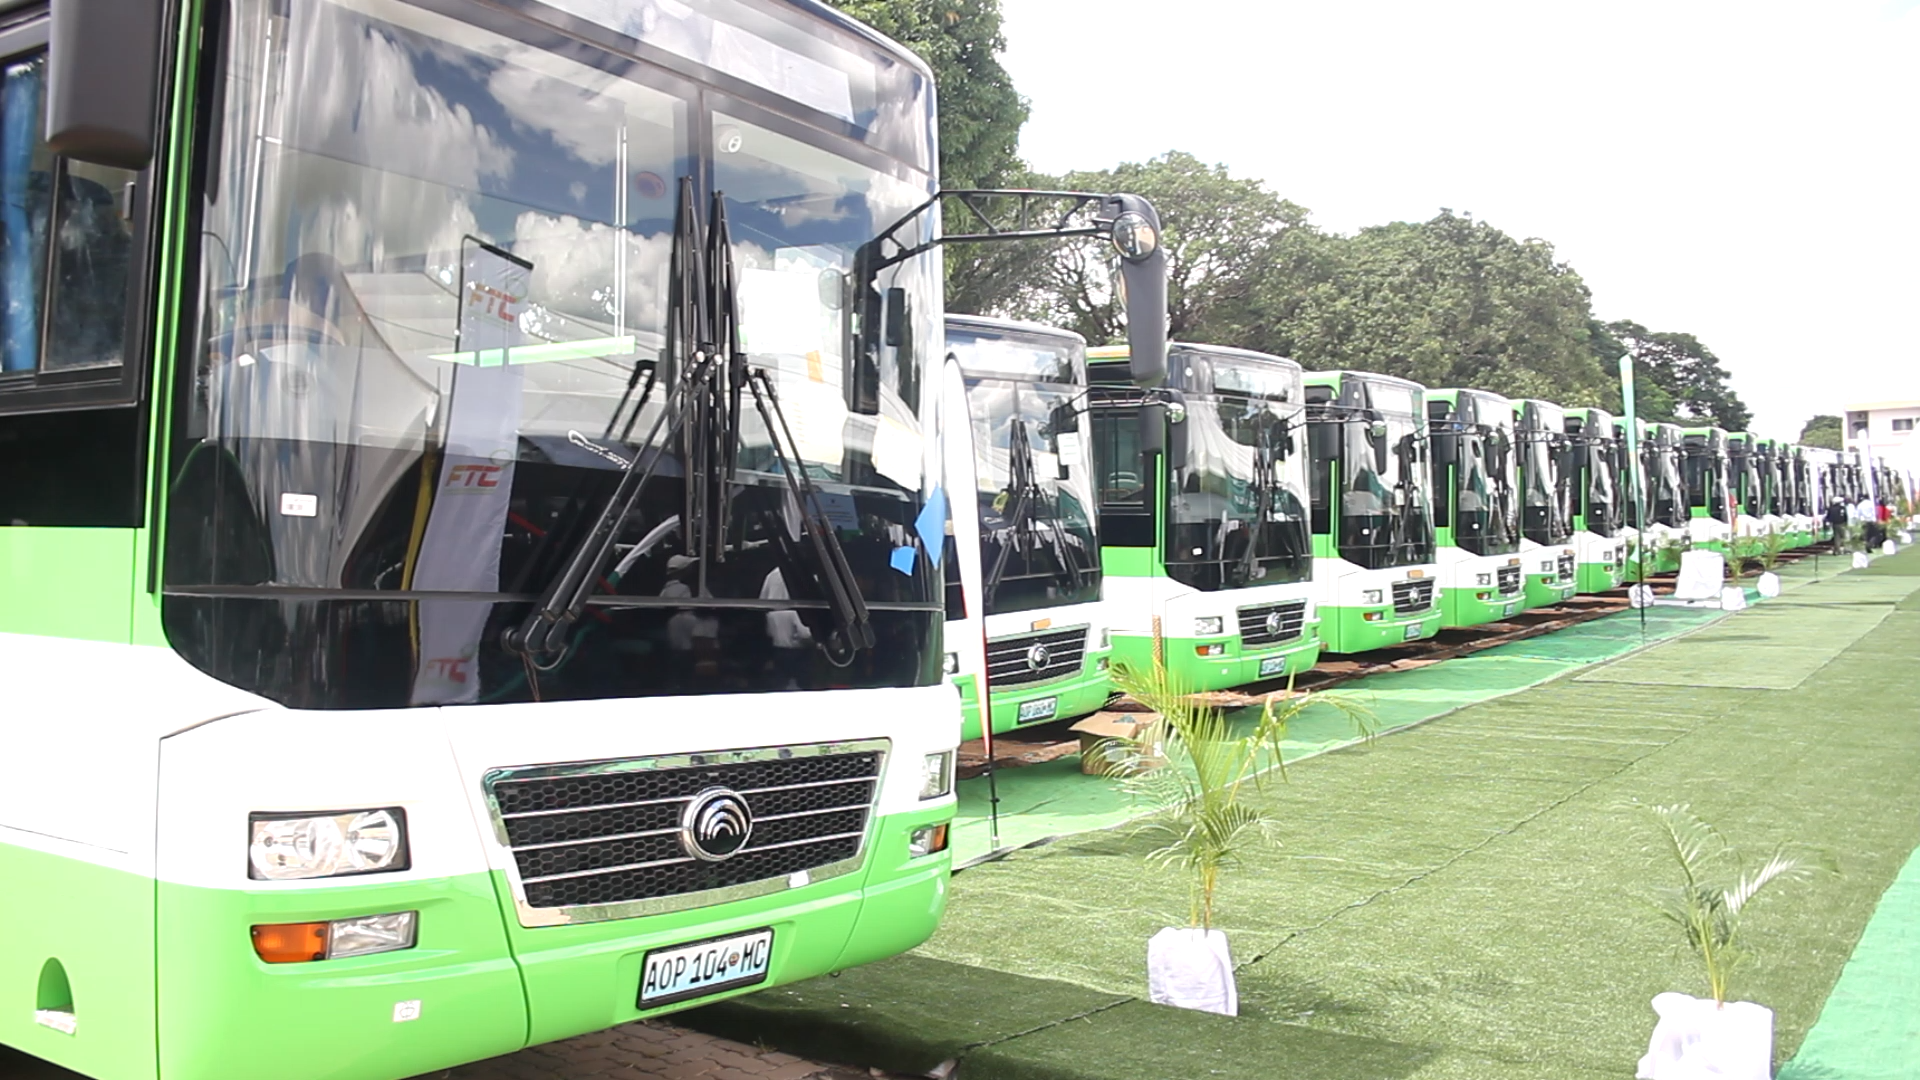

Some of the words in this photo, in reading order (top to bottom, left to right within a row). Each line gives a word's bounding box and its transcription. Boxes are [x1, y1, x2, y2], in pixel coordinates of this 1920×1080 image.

[469, 284, 516, 322] FTC
[446, 465, 500, 487] FTC
[424, 657, 469, 684] FTC
[644, 956, 687, 993] AOP
[689, 946, 729, 984] 104
[741, 939, 766, 973] MC
